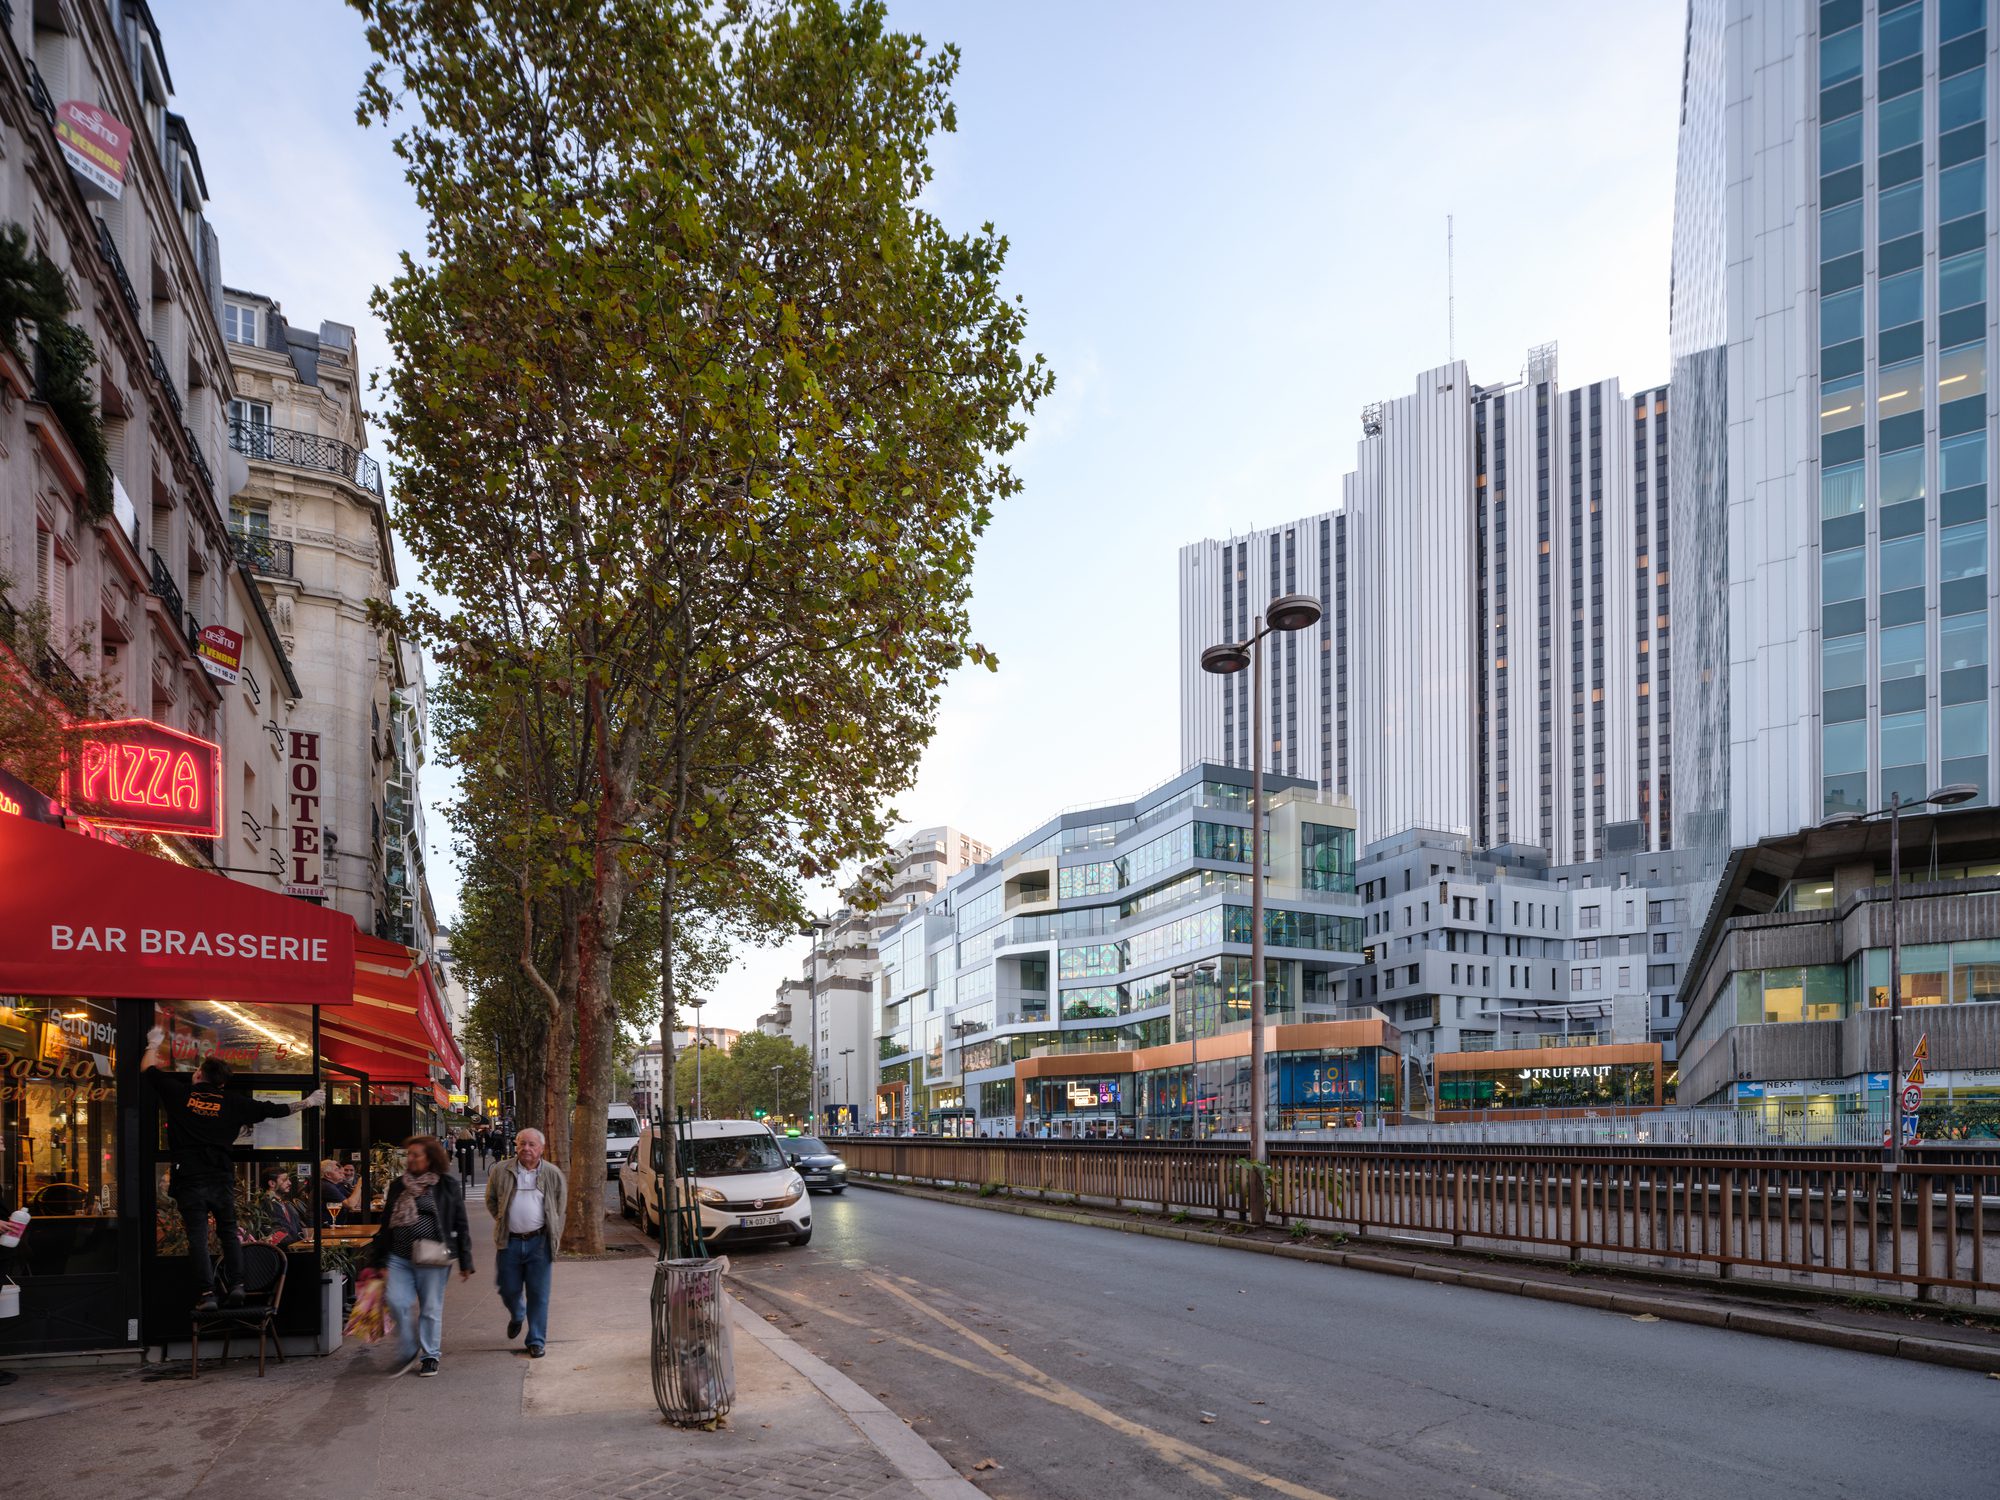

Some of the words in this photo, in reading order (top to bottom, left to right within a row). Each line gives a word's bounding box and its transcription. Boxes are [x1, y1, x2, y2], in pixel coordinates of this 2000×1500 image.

[206, 647, 237, 667] VENDRE
[82, 740, 199, 809] PIZZA
[289, 731, 320, 886] HOTEL
[287, 886, 325, 897] TRAITEUR
[51, 925, 127, 953] BAR
[140, 928, 328, 962] BRASSERIE
[1533, 1065, 1611, 1079] TRUFFAUT
[1738, 1071, 1752, 1079] 66
[186, 1097, 222, 1112] pizza
[1905, 1091, 1919, 1105] 30
